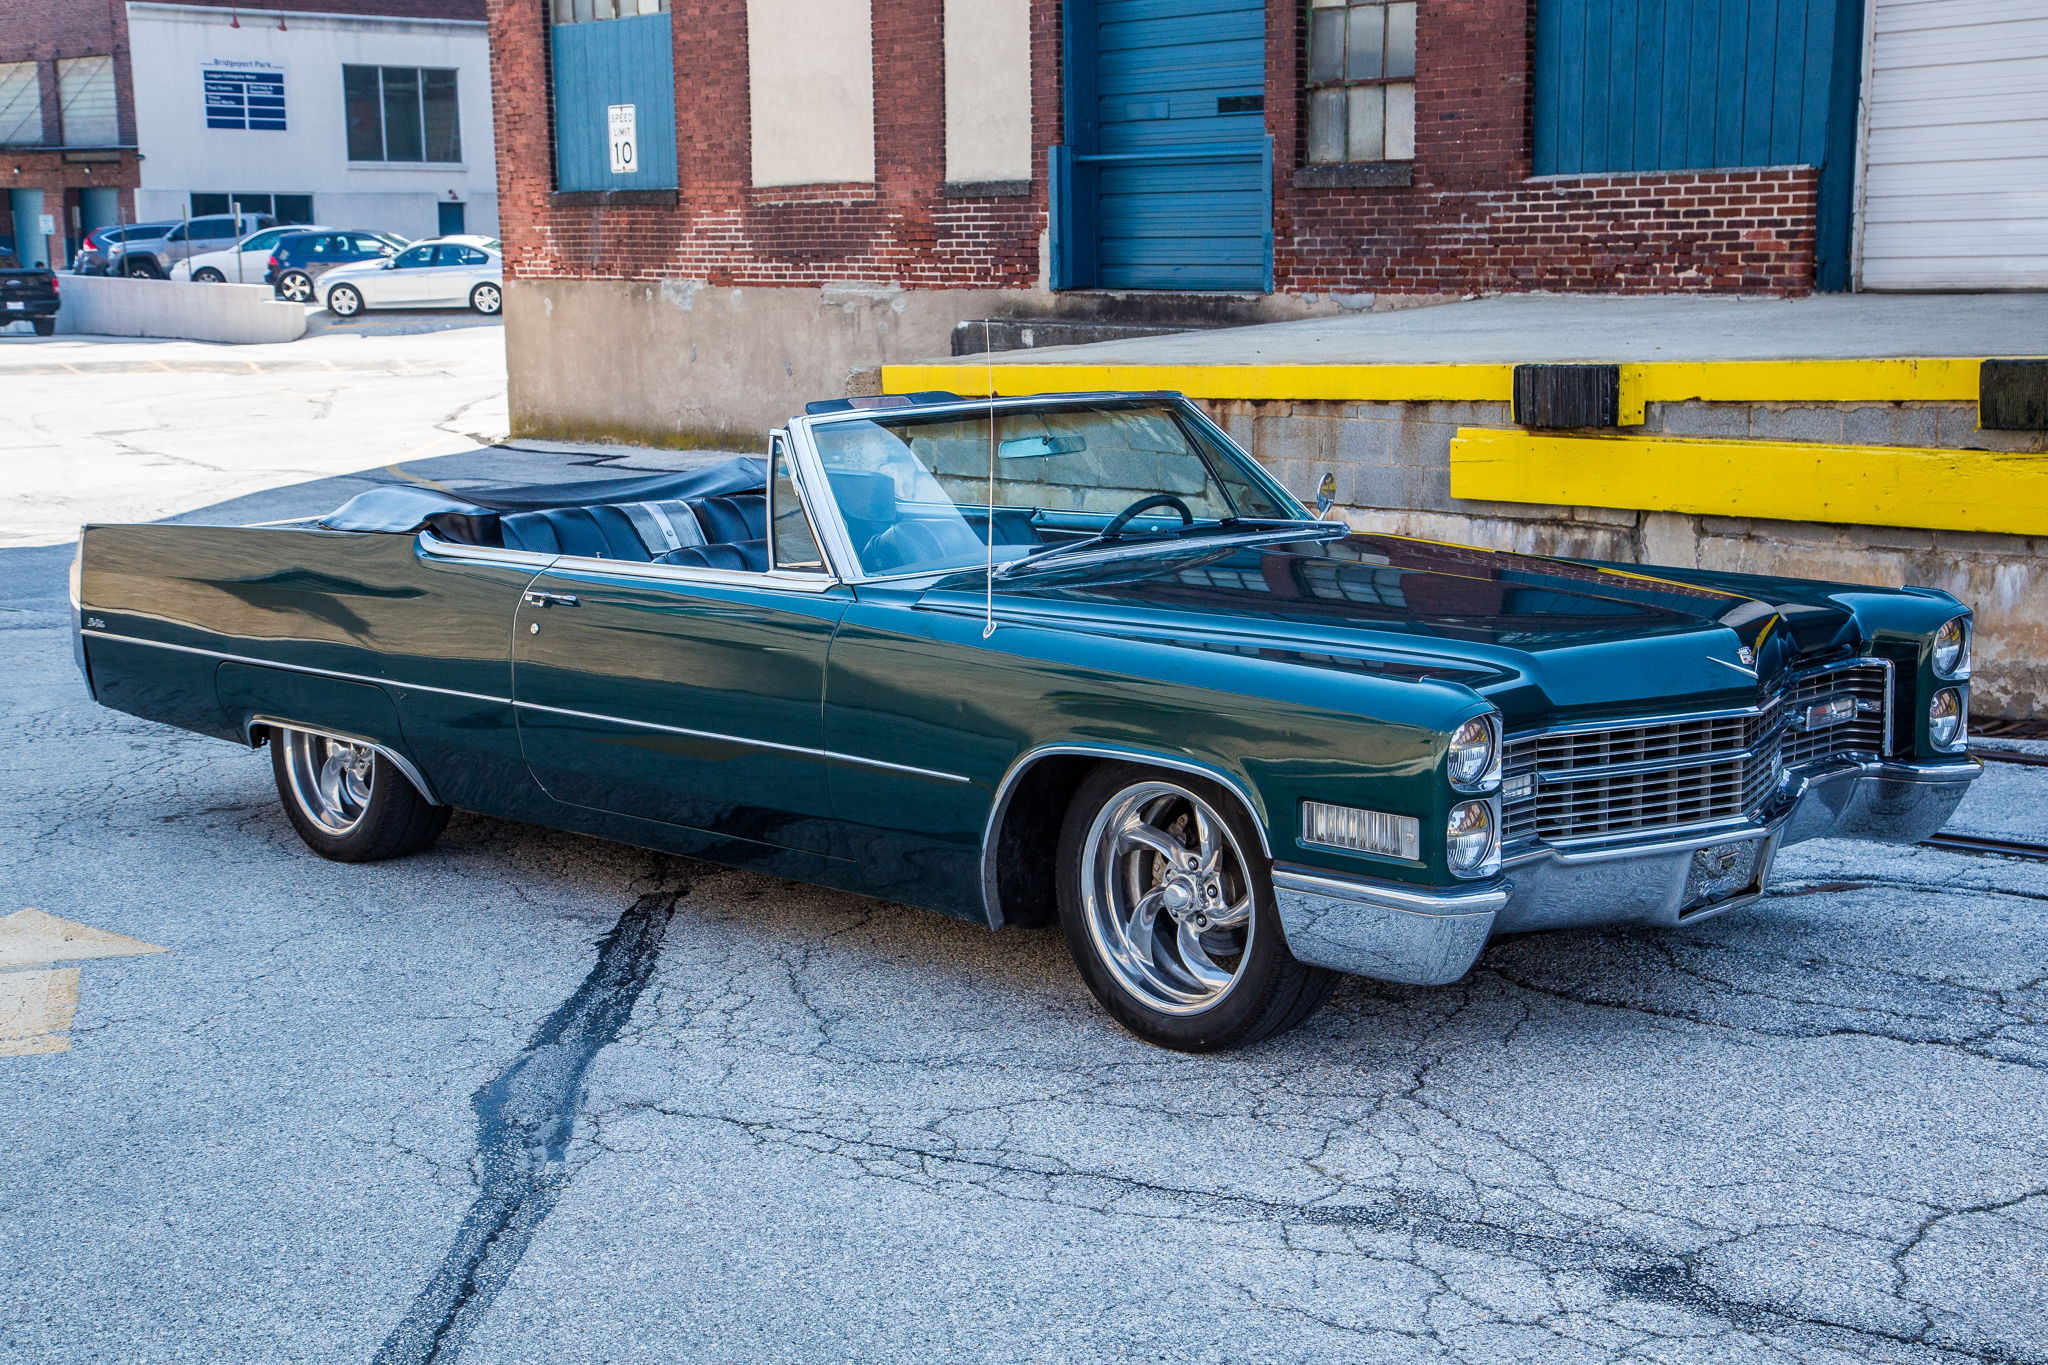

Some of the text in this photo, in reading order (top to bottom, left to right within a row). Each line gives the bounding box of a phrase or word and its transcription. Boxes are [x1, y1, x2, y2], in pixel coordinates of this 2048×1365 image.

[213, 58, 271, 68] Bridgeport Park
[611, 113, 632, 123] SPEED
[613, 127, 631, 137] LIMIT
[614, 141, 632, 165] 10
